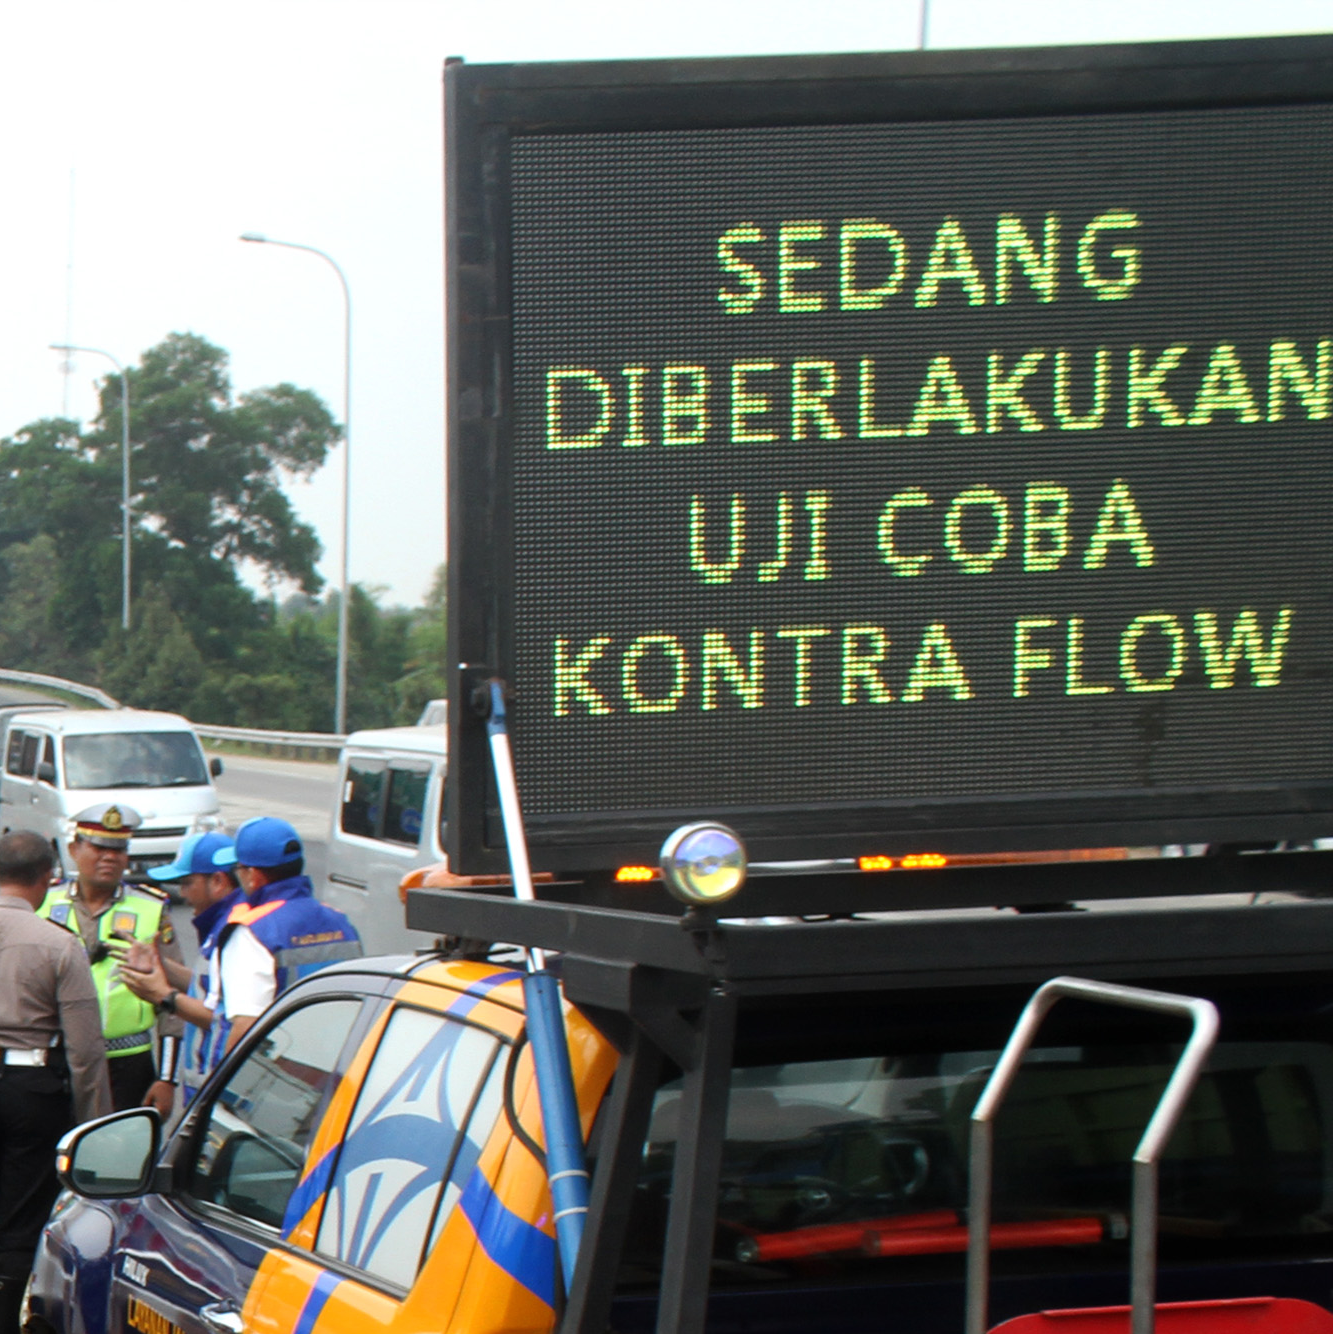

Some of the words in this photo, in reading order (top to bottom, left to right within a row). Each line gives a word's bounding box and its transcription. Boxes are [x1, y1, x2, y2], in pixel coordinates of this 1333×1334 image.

[717, 209, 1142, 315] SEDANG
[546, 338, 1333, 450] DIBERLAKUKAN
[689, 490, 831, 584] UJI
[877, 479, 1156, 576] COBA
[553, 620, 976, 717] KONTRA
[1013, 608, 1295, 697] FLOW
